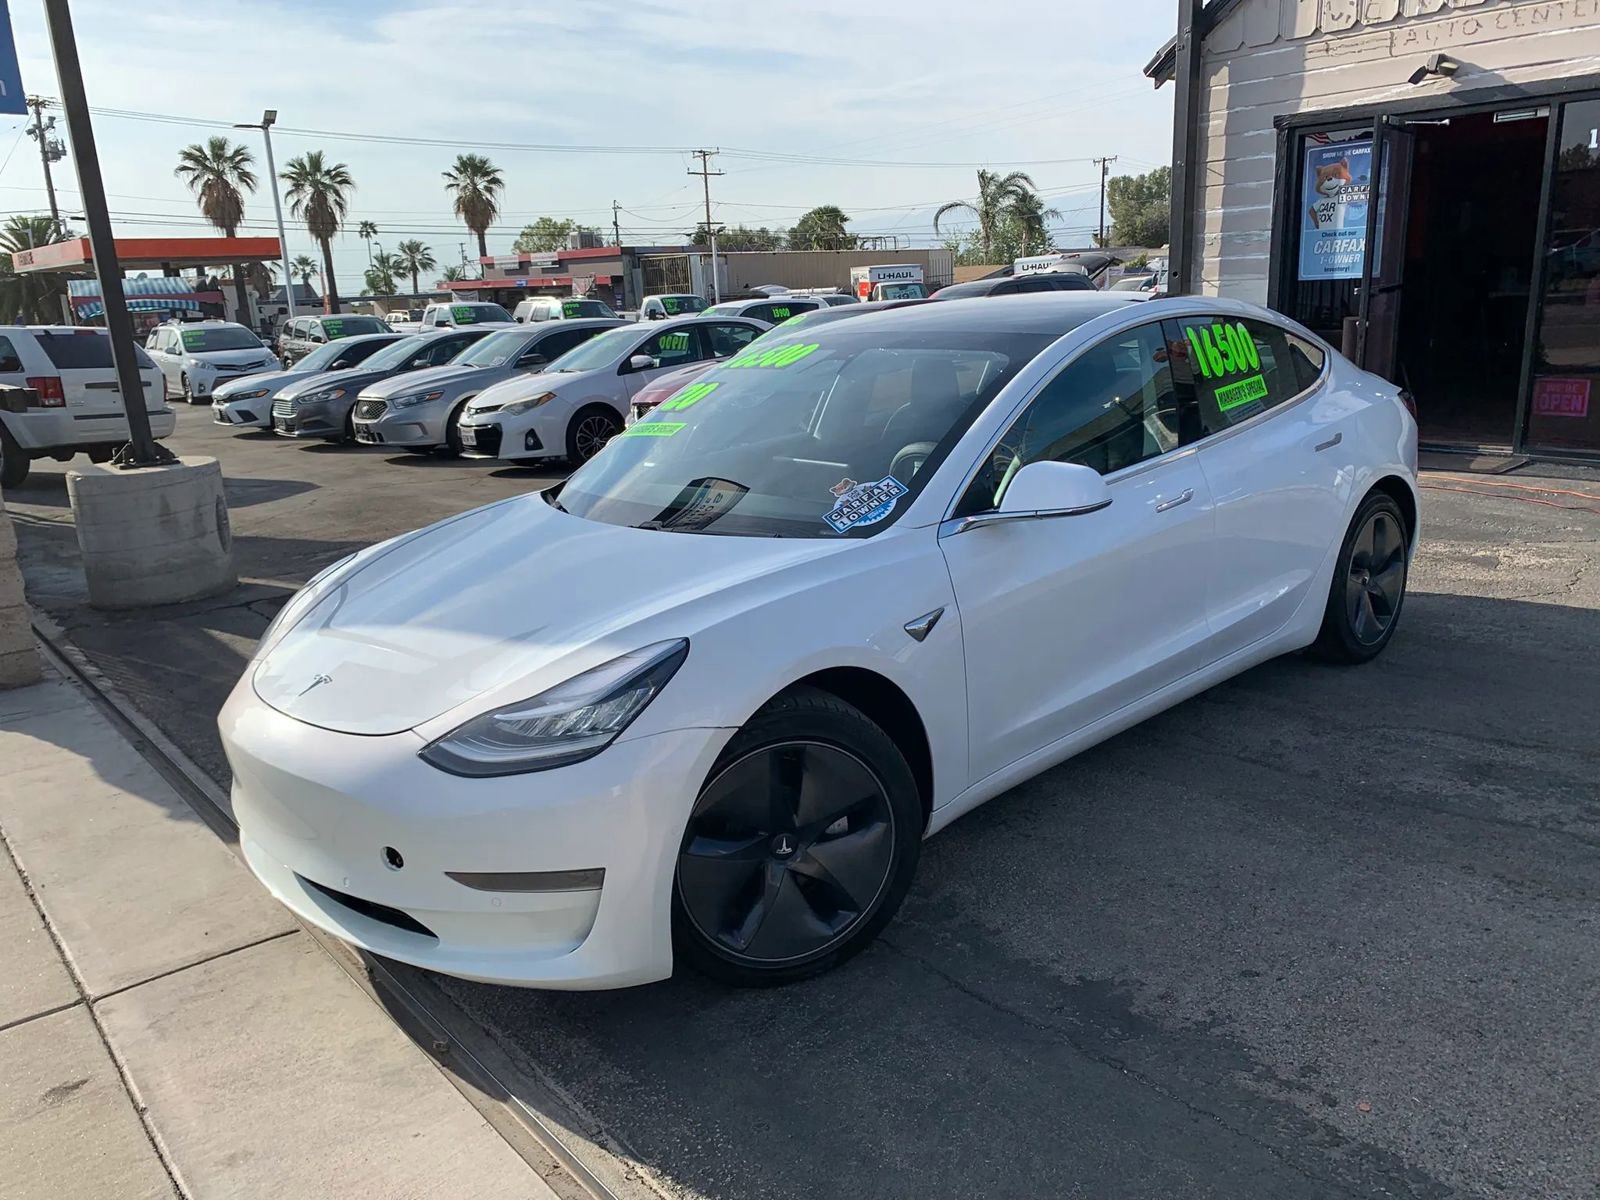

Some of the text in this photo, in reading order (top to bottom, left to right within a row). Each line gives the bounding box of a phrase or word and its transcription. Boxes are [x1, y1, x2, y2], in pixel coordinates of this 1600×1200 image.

[1403, 18, 1483, 47] AUTO
[1339, 185, 1370, 194] CARF
[1346, 193, 1370, 201] OWN
[1319, 203, 1336, 213] CAR
[1313, 238, 1366, 254] CARFAX
[1021, 262, 1052, 271] U-HAU
[877, 271, 915, 280] U-HAUL
[1186, 322, 1260, 378] 16500
[1539, 393, 1583, 411] OPEN
[831, 482, 893, 520] CARFAX
[849, 485, 900, 521] OWNER
